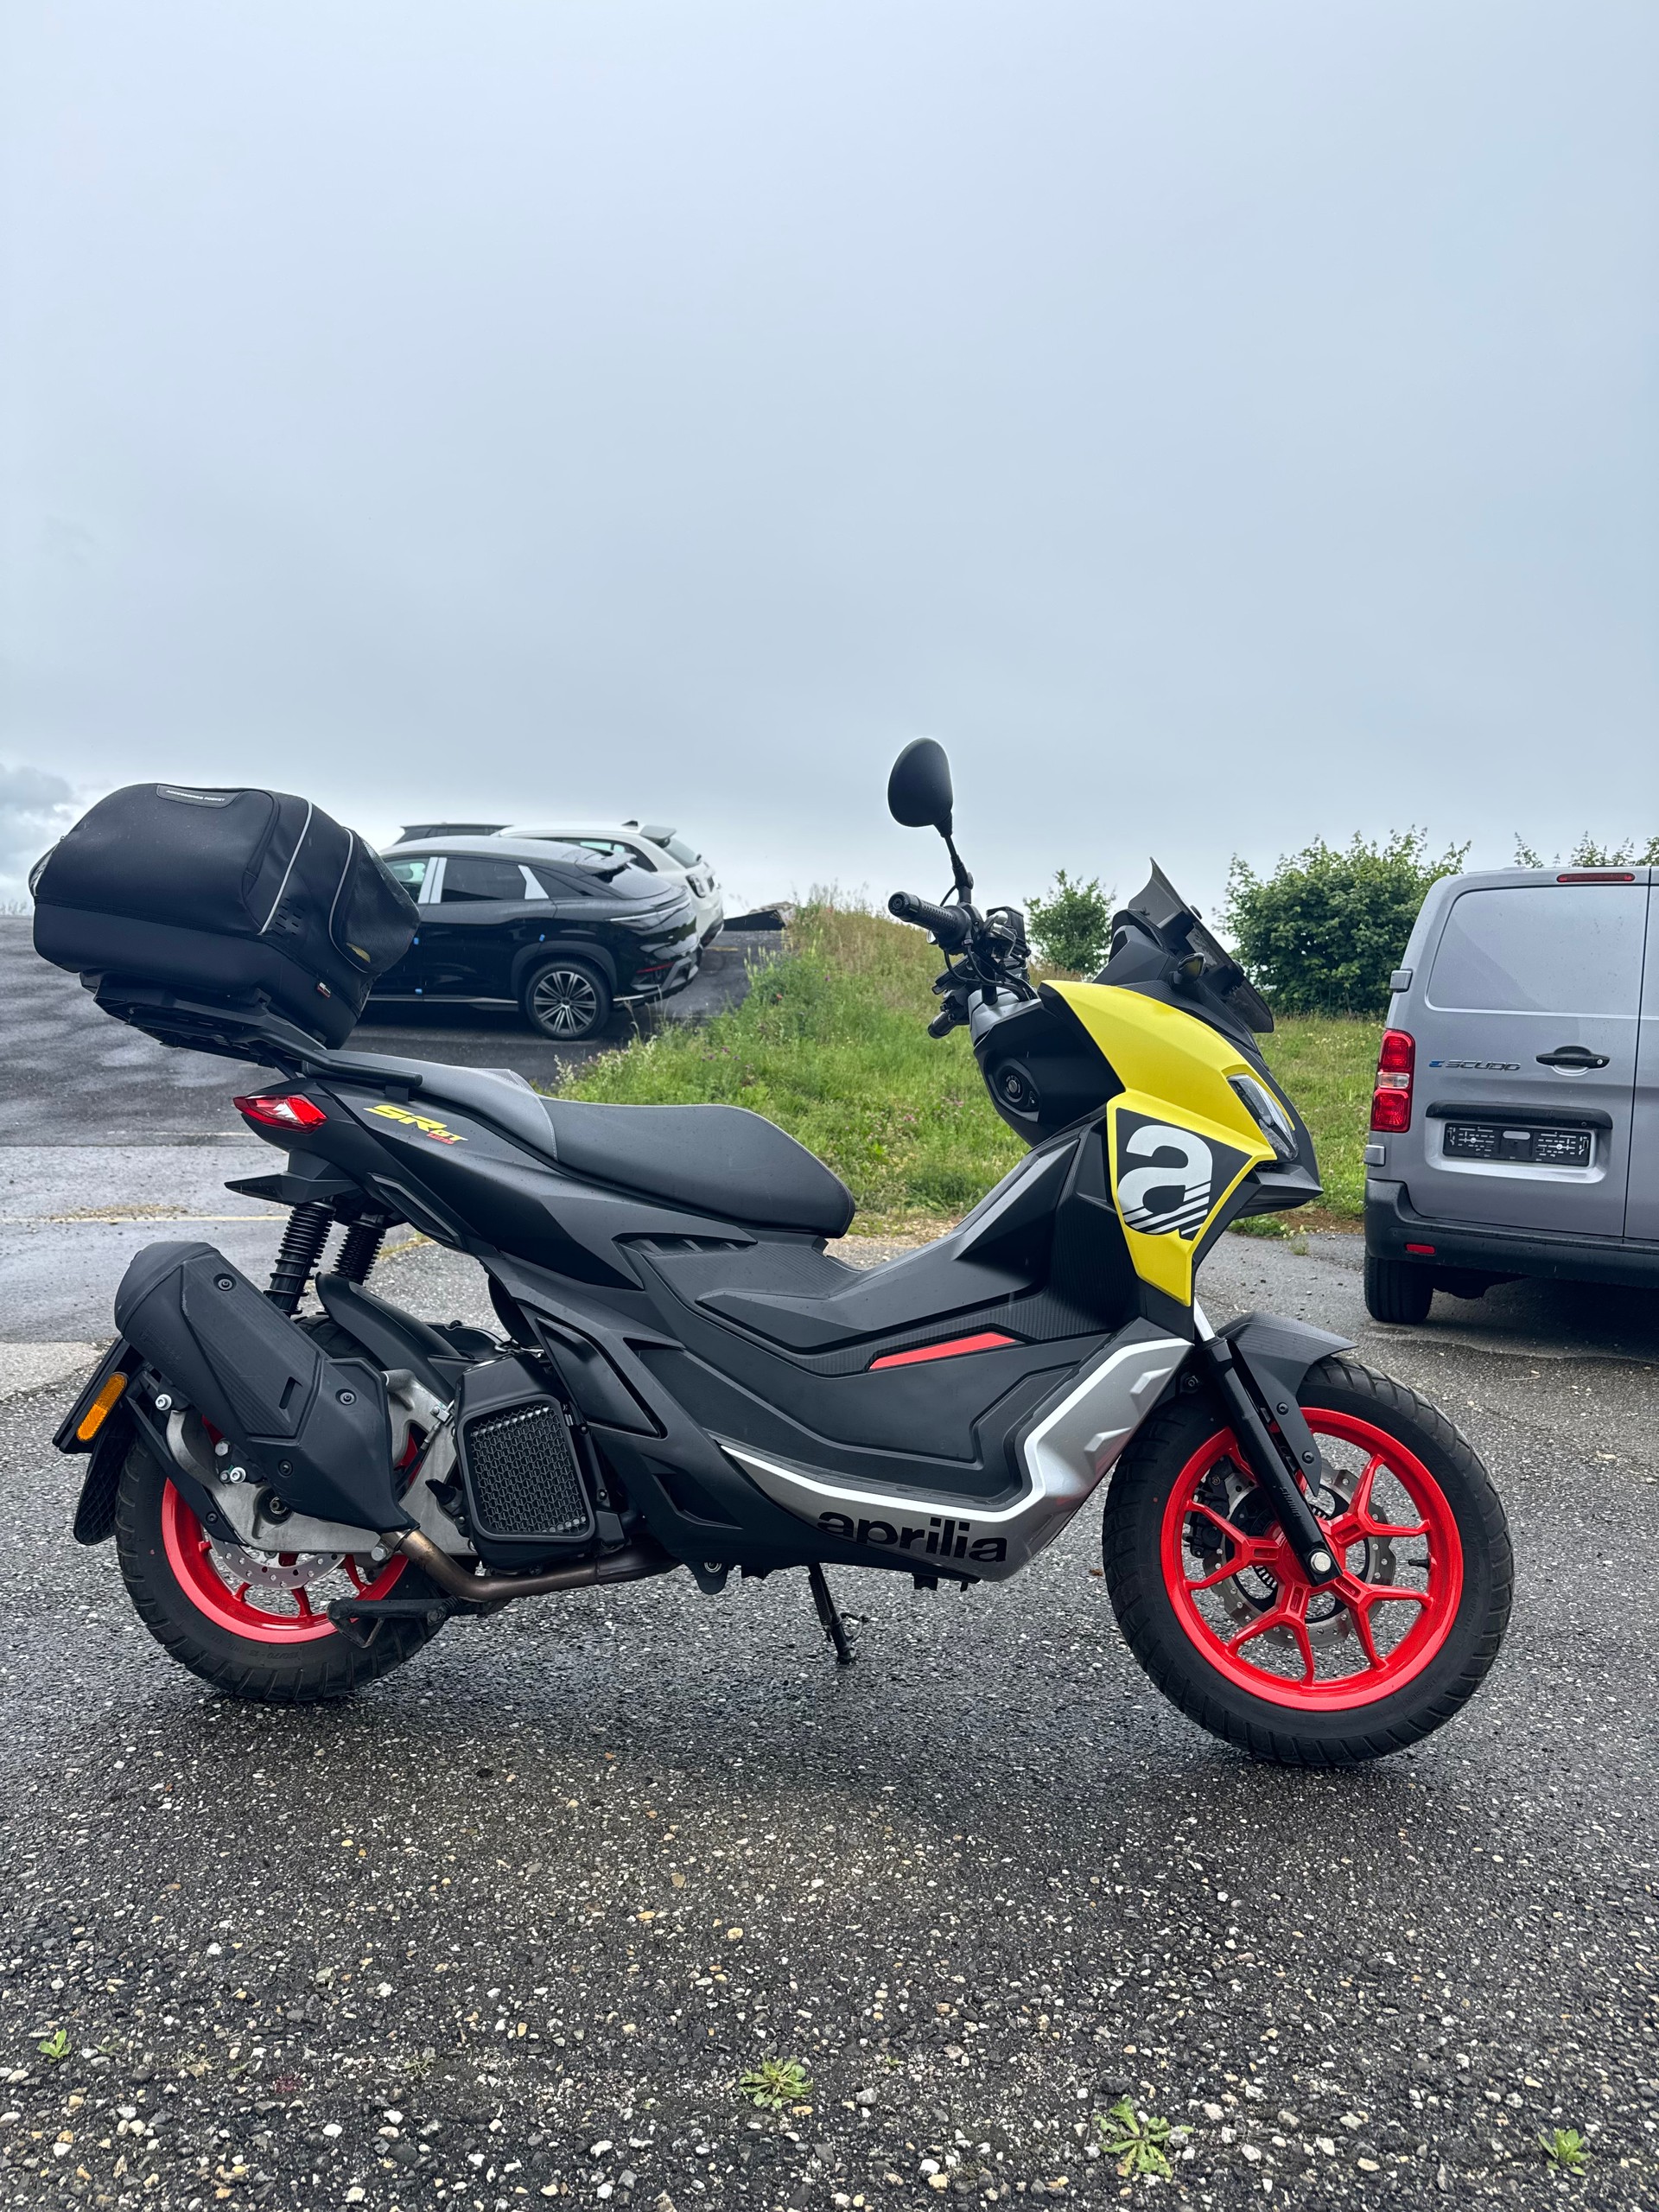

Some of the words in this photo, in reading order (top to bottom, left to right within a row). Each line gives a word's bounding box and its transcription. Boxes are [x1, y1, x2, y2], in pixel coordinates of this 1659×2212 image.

[1445, 1059, 1521, 1071] SCUDO
[362, 1104, 448, 1133] SR
[817, 1511, 1007, 1563] aprilia
